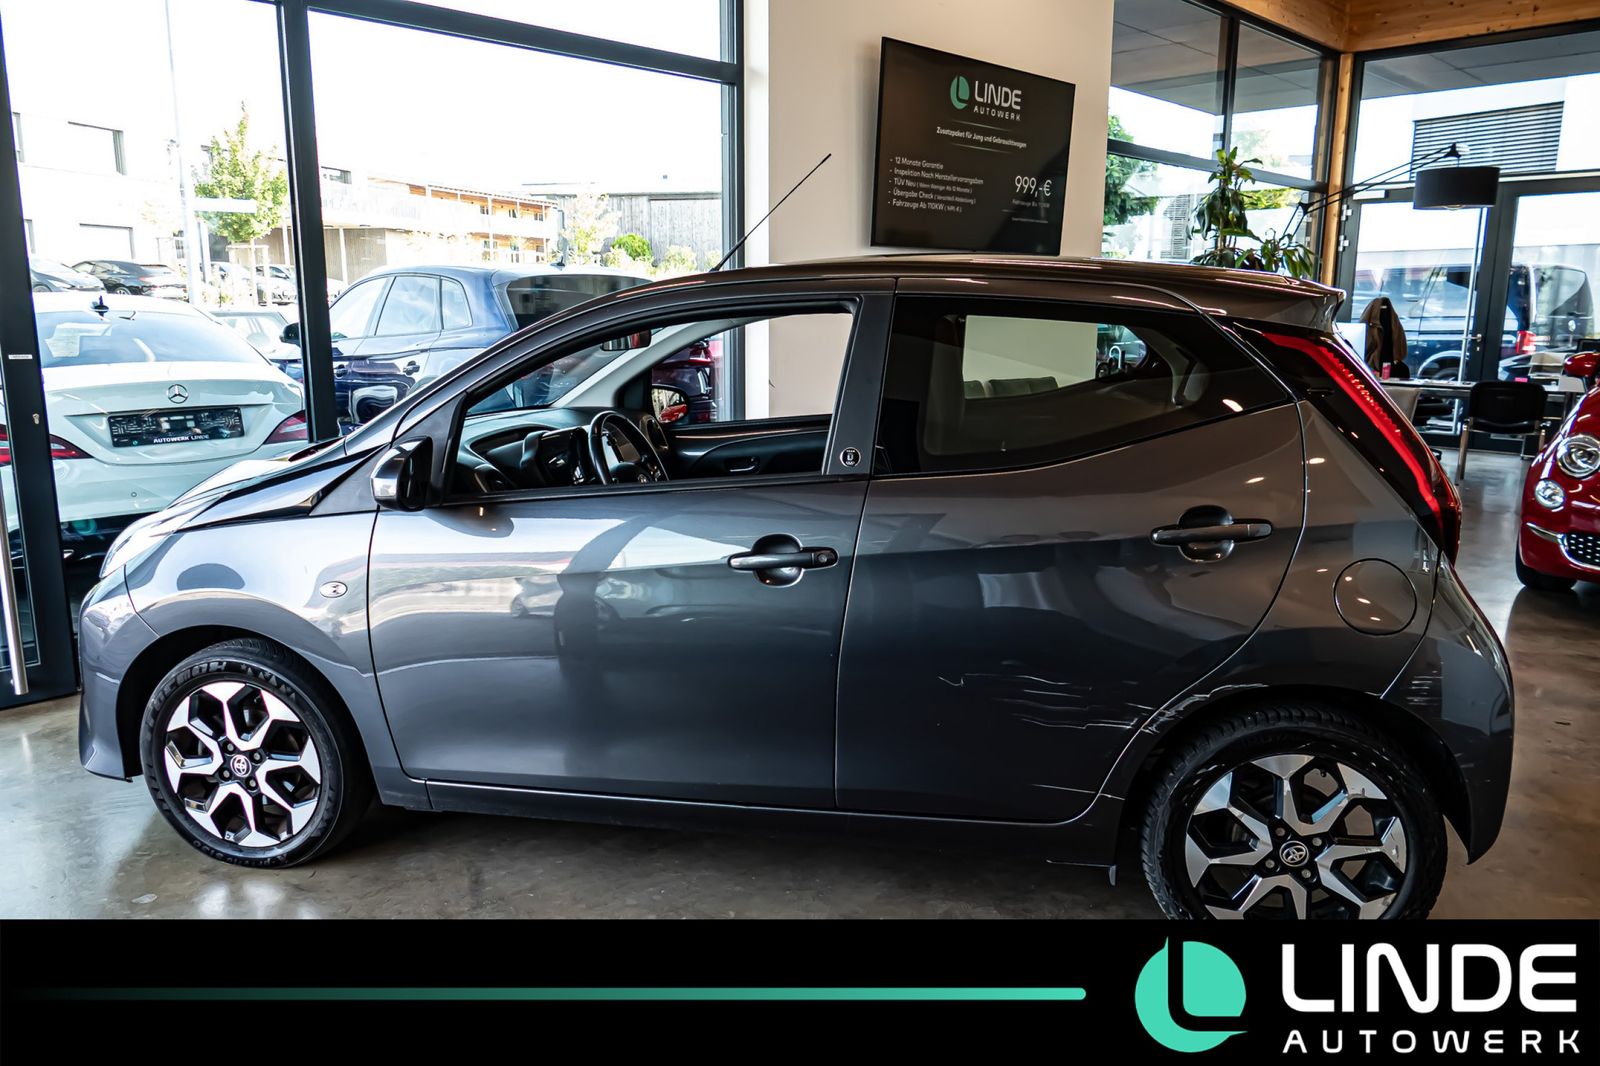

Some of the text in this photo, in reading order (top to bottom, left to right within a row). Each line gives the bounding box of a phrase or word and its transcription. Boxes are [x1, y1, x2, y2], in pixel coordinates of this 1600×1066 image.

[974, 80, 1022, 110] LINDE
[973, 105, 1021, 120] AUTOWERK
[973, 133, 984, 142] Jung
[902, 157, 921, 167] Monate
[922, 160, 944, 170] Garantie
[894, 167, 920, 177] Inspektion
[921, 170, 934, 178] Nach
[894, 177, 904, 186] TÜV
[918, 190, 934, 199] Check
[892, 198, 919, 210] Fahrzeuge
[153, 436, 189, 444] AUTOWERK
